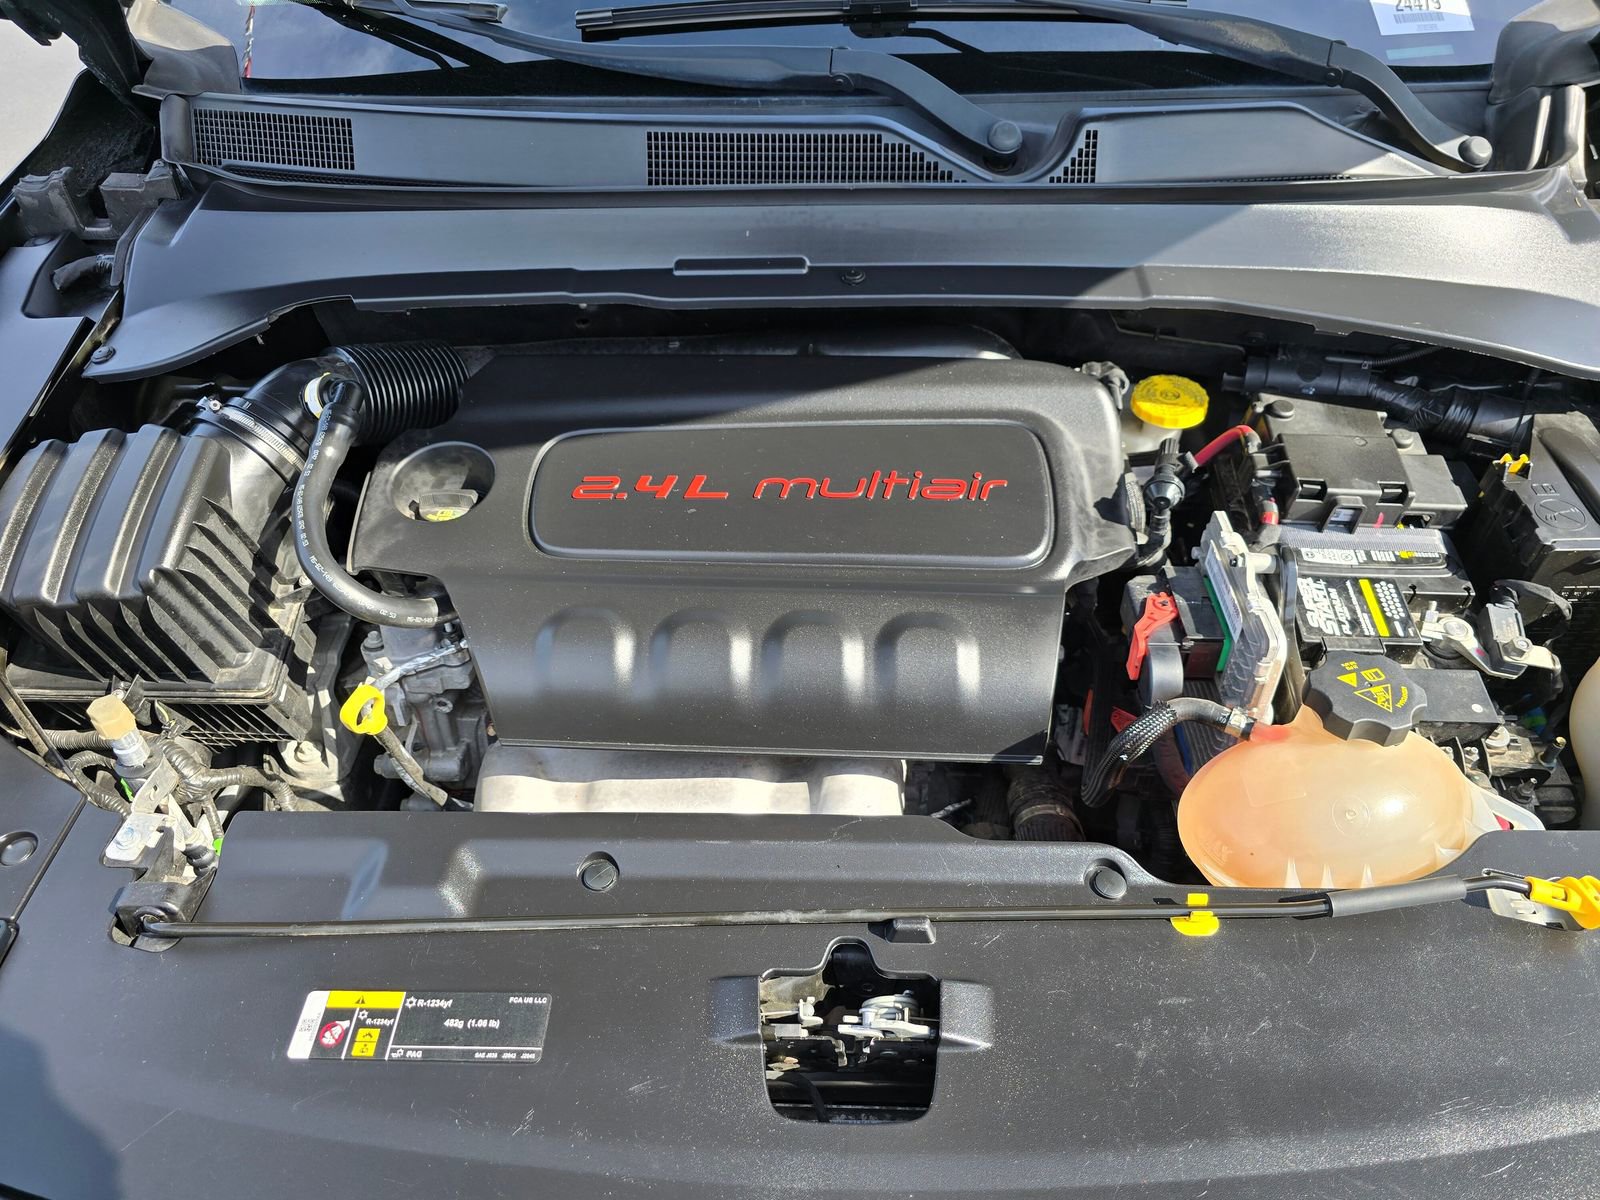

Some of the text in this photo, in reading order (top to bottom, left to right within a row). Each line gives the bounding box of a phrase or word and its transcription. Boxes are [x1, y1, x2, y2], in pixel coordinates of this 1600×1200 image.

[752, 470, 1008, 501] multiair
[417, 998, 453, 1009] R-1234yf
[508, 996, 523, 1004] FCA
